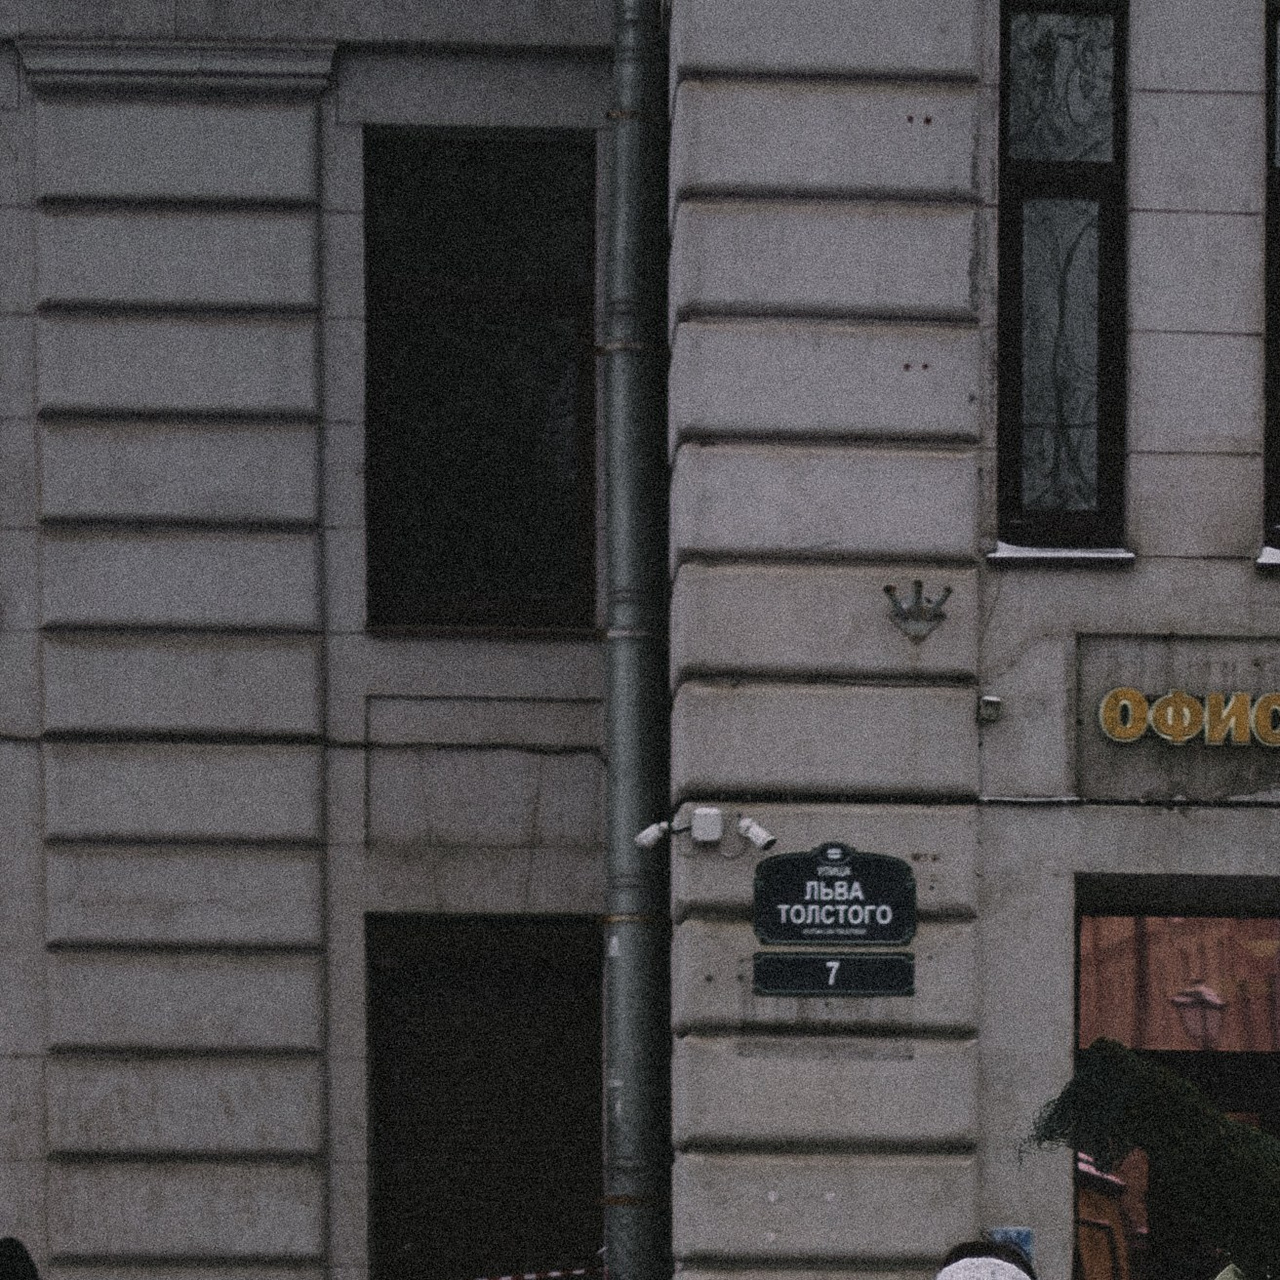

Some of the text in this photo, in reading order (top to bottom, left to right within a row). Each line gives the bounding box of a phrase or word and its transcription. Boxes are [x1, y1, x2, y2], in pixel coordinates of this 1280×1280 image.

[804, 880, 866, 901] ЛЬВА
[777, 904, 894, 925] ТОЛСТОГО
[825, 961, 841, 986] 7
